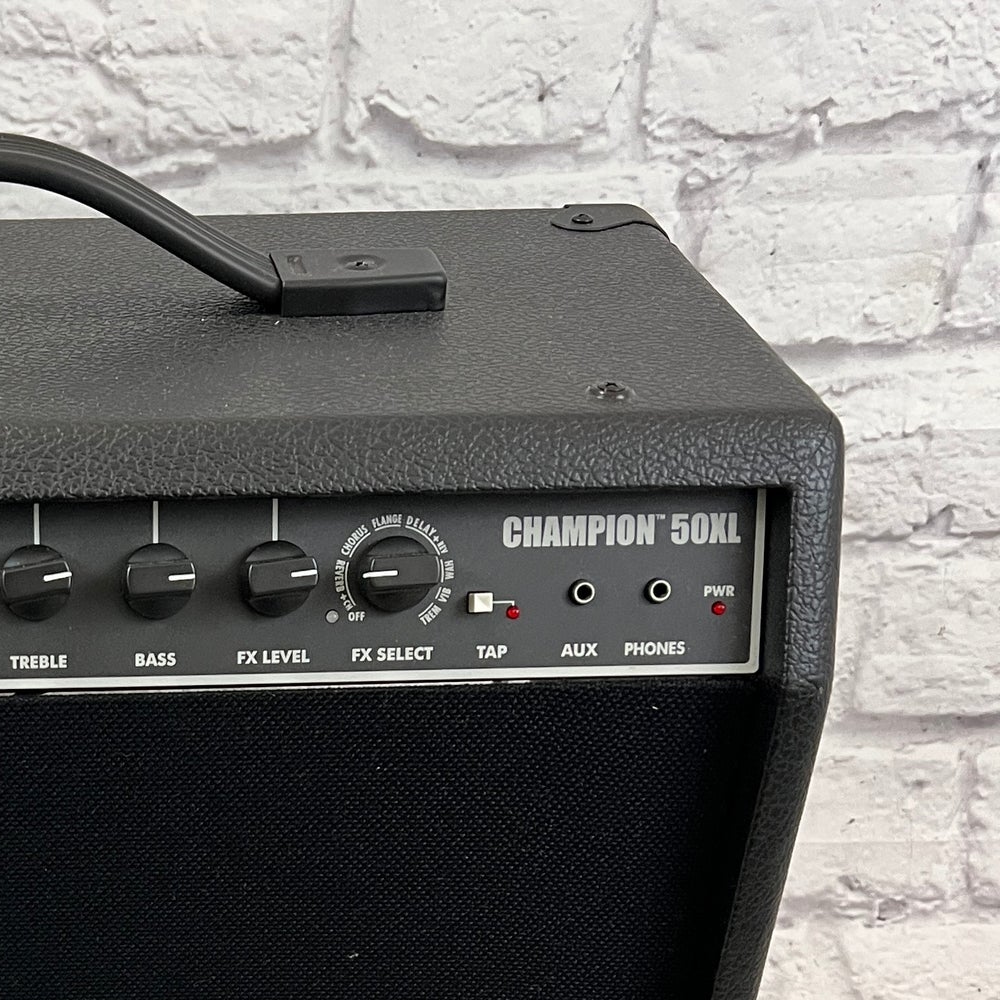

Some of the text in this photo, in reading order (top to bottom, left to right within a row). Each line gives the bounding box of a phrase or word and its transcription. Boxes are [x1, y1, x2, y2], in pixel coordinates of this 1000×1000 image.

[371, 514, 402, 528] FLANGE
[670, 512, 741, 545] 50XL
[341, 524, 369, 555] CHORUS
[334, 559, 346, 593] REVERB
[444, 559, 455, 580] WAH
[437, 587, 452, 603] VIB
[703, 585, 735, 597] PWR
[348, 611, 365, 622] OFF
[419, 604, 442, 625] TREM
[236, 648, 310, 665] FX LEVEL
[351, 646, 434, 662] FX SELECT
[476, 644, 508, 659] TAP
[561, 642, 598, 658] AUX
[624, 641, 686, 656] PHONES
[10, 654, 68, 670] TREBLE
[135, 652, 177, 667] BASS
